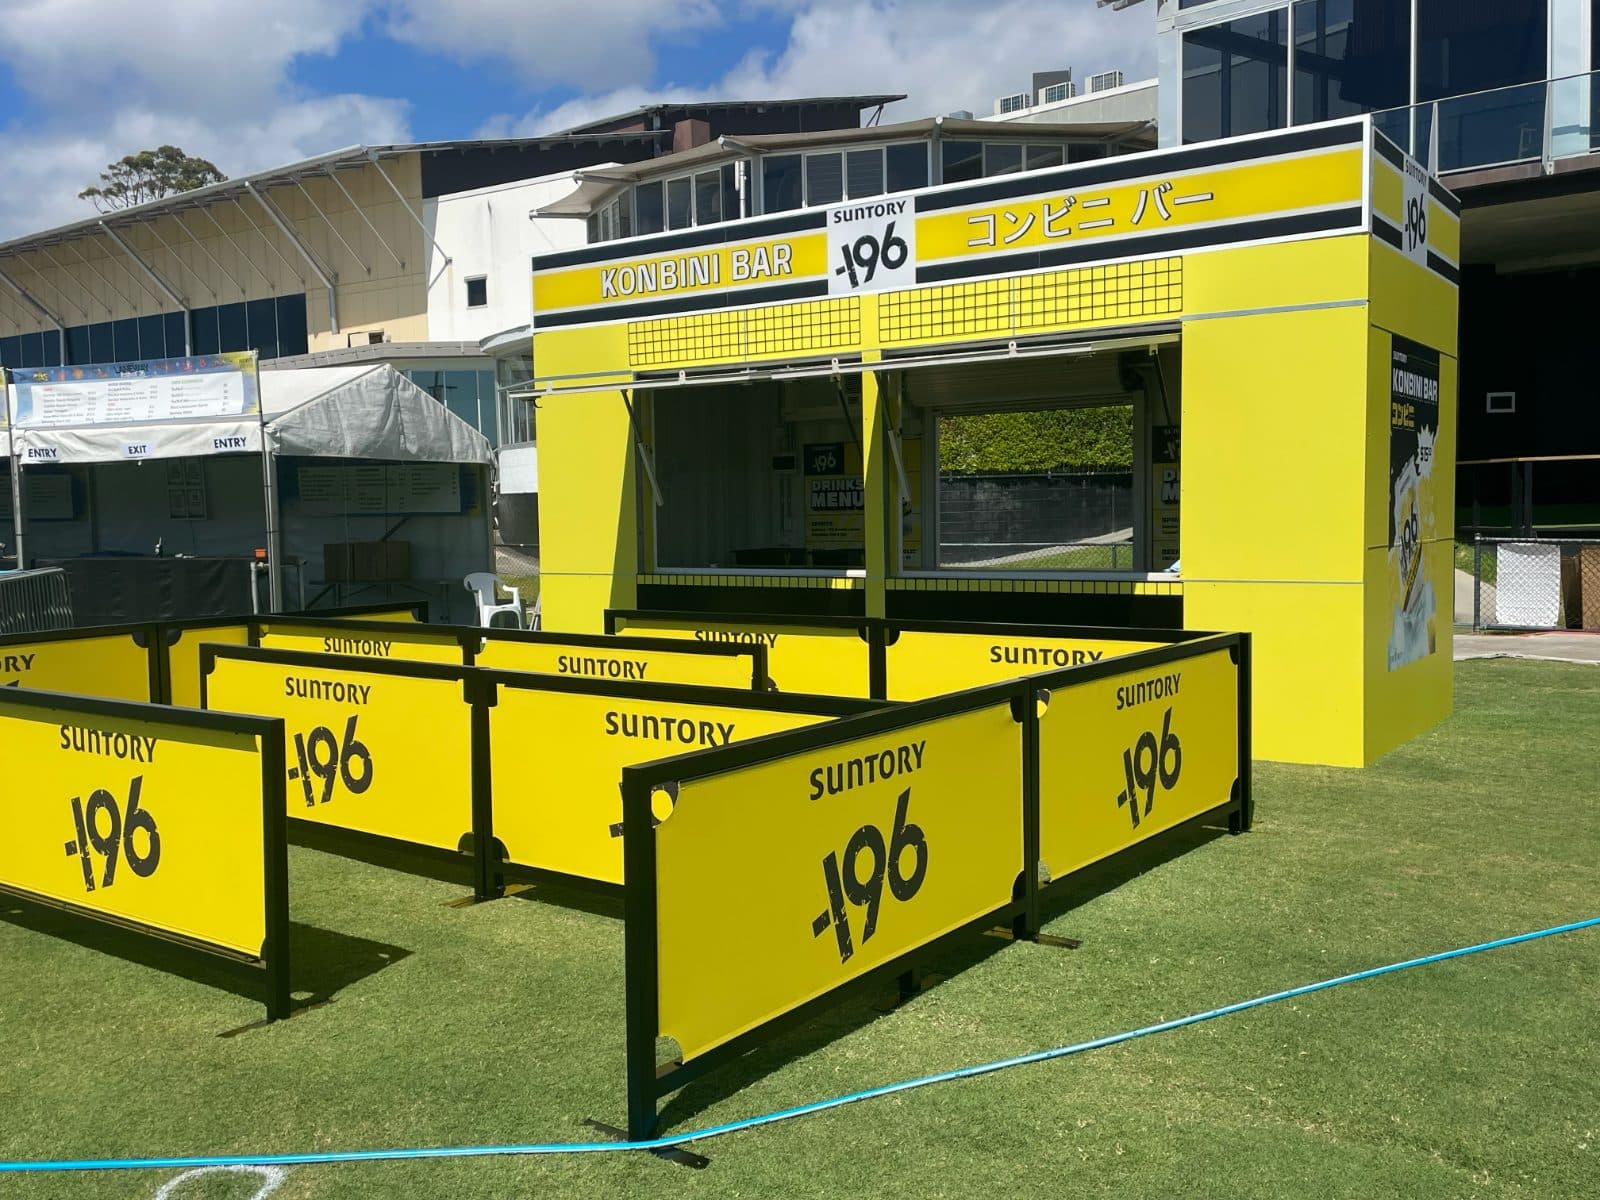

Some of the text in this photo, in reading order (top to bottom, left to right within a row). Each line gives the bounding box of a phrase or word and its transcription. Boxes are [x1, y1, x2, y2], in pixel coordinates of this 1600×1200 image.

[833, 200, 906, 224] SUNTORY
[967, 181, 1214, 247] コンビニ バー
[600, 243, 793, 299] KONBINI BAR
[835, 220, 909, 289] -196
[1392, 367, 1438, 402] KONBINI BAR
[28, 448, 57, 458] ENTRY
[128, 445, 147, 455] EXIT
[213, 436, 247, 449] ENTRY
[811, 491, 864, 508] MENU
[812, 479, 864, 490] DRINKS
[0, 653, 36, 673] RY
[323, 636, 392, 657] SUNTORY
[558, 655, 648, 679] SUNTORY
[285, 676, 371, 705] SUNTORY
[1116, 673, 1182, 711] SUNTORY
[60, 724, 157, 763] SUNTORY
[605, 711, 735, 747] SUNTORY
[288, 714, 374, 808] -196
[809, 740, 926, 801] SUNTORY
[1117, 706, 1182, 830] -196
[64, 775, 161, 893] -196
[812, 786, 929, 965] -196
